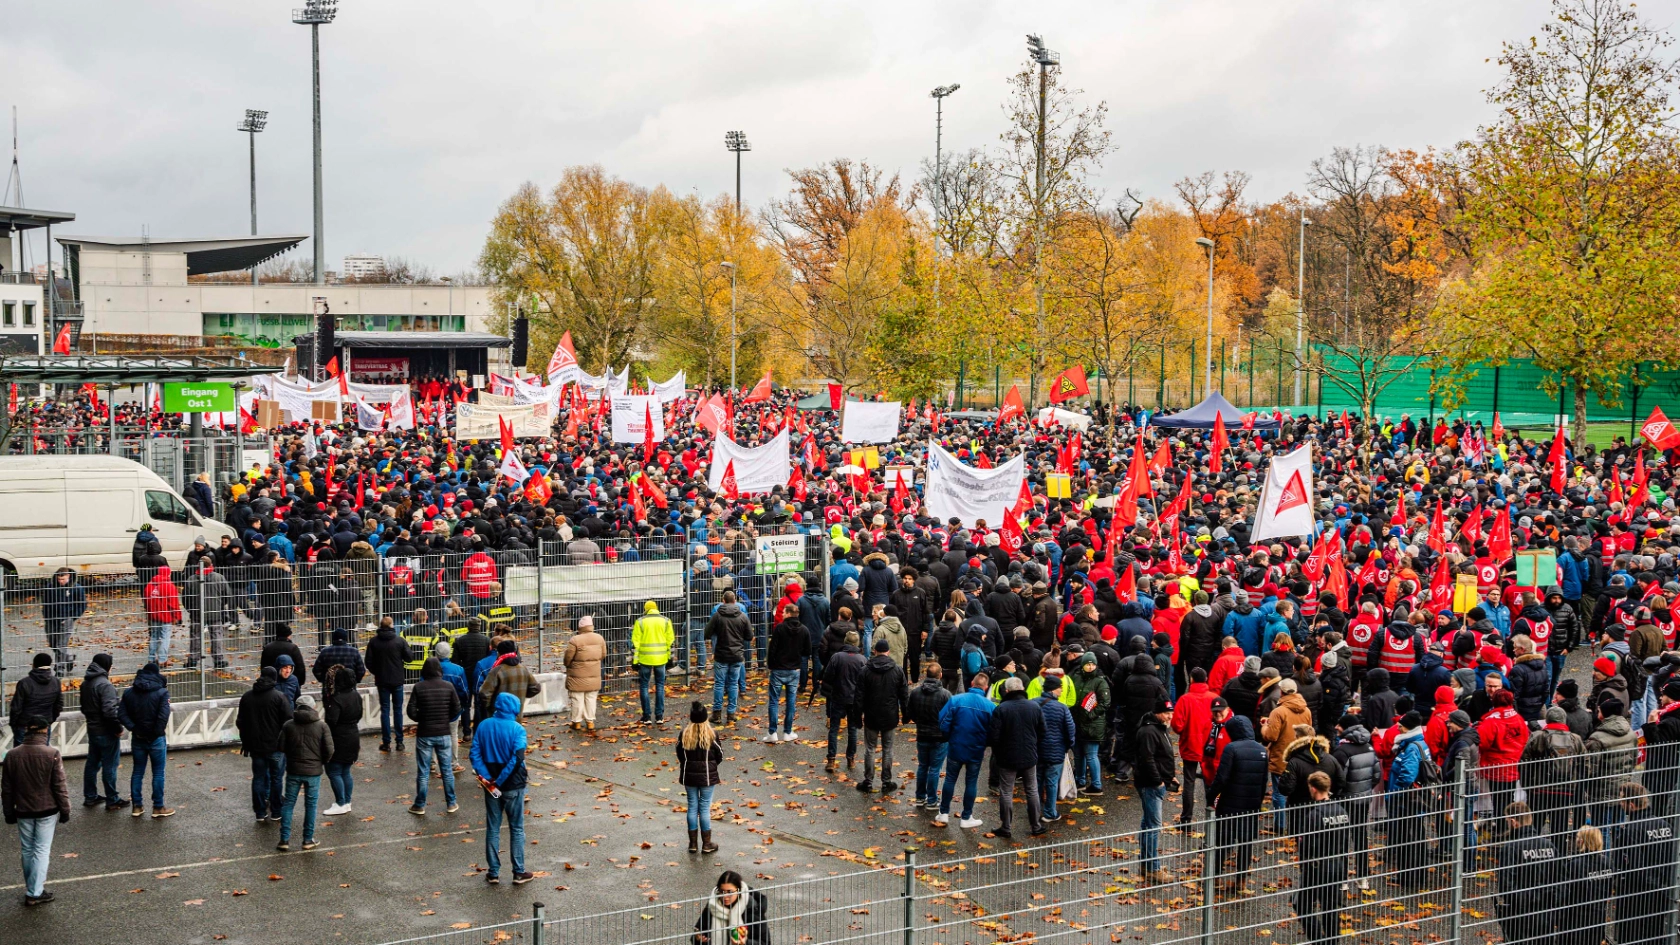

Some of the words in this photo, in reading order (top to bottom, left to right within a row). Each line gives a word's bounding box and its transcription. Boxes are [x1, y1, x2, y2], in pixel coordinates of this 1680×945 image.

[181, 388, 218, 397] Eingang
[188, 399, 205, 408] Ost
[1522, 847, 1554, 859] POLIZEI
